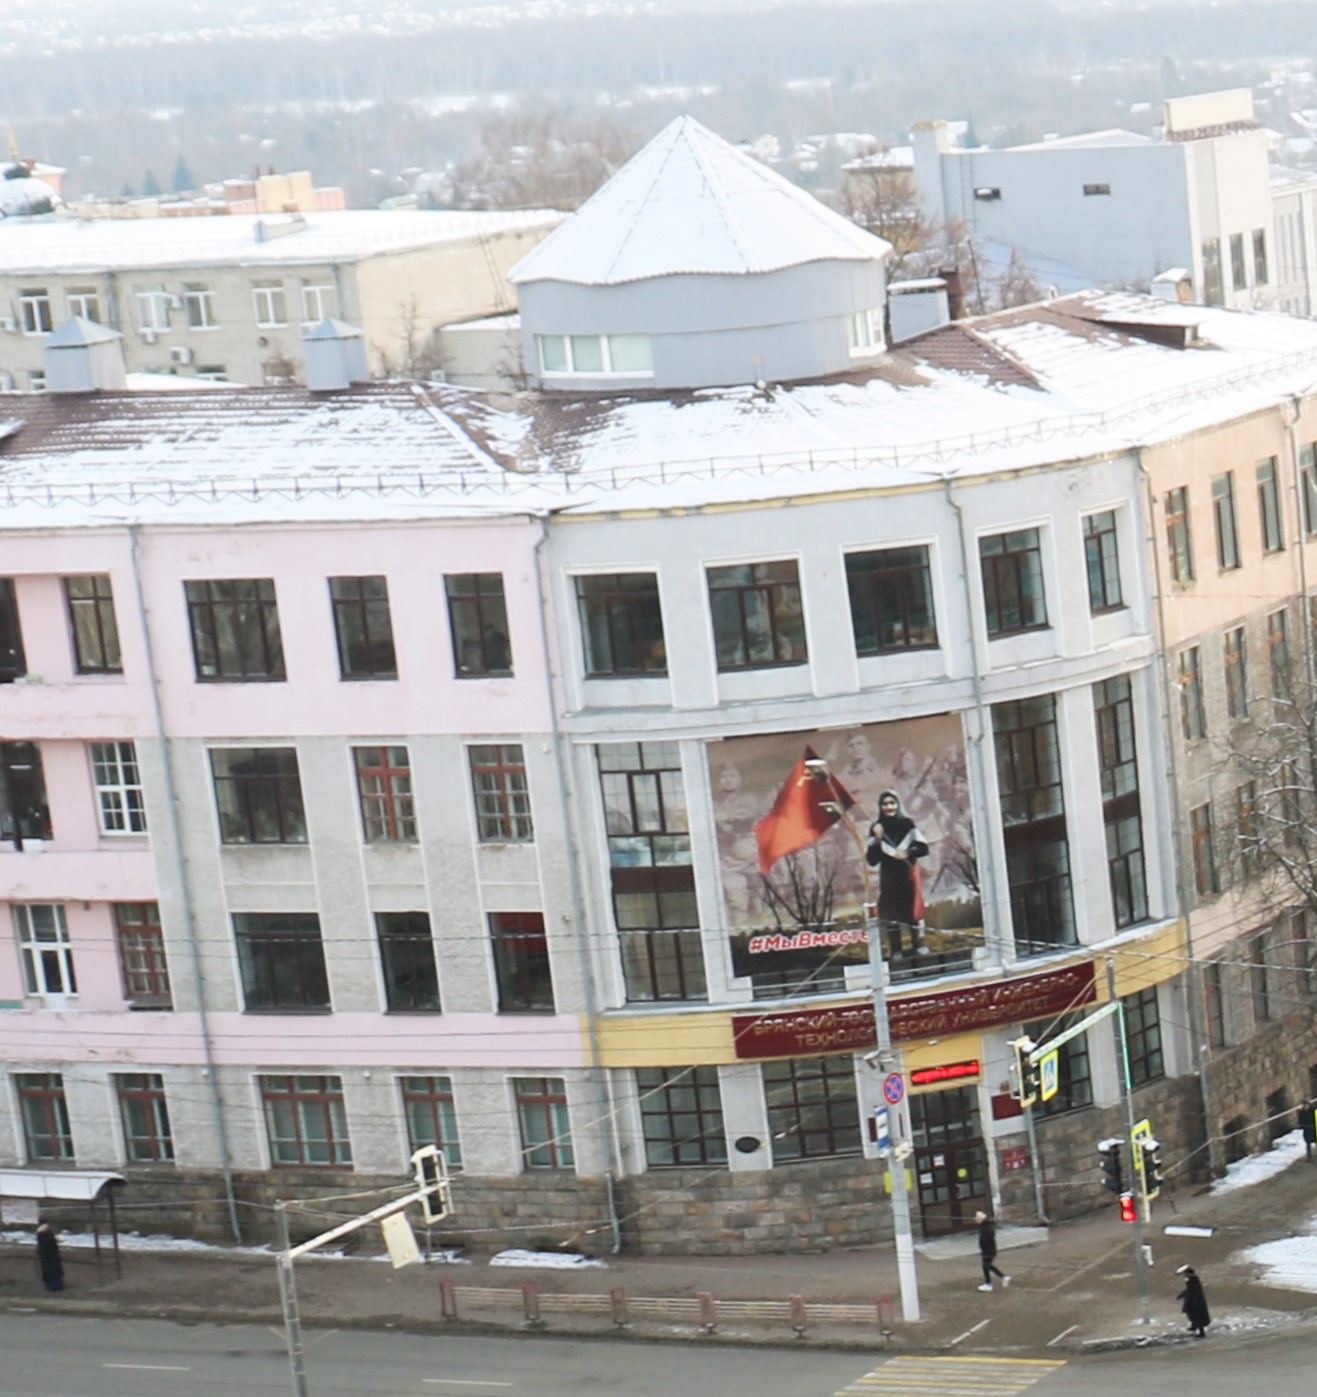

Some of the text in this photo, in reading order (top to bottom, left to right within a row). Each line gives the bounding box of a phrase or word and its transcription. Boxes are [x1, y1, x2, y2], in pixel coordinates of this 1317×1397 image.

[749, 928, 870, 953] #МыВместе
[754, 1011, 838, 1035] БРЯНСКИЙ
[992, 971, 1079, 1003] ИНЖЕНЕРНО-
[951, 1000, 1049, 1026] УНИВЕРСИТЕТ
